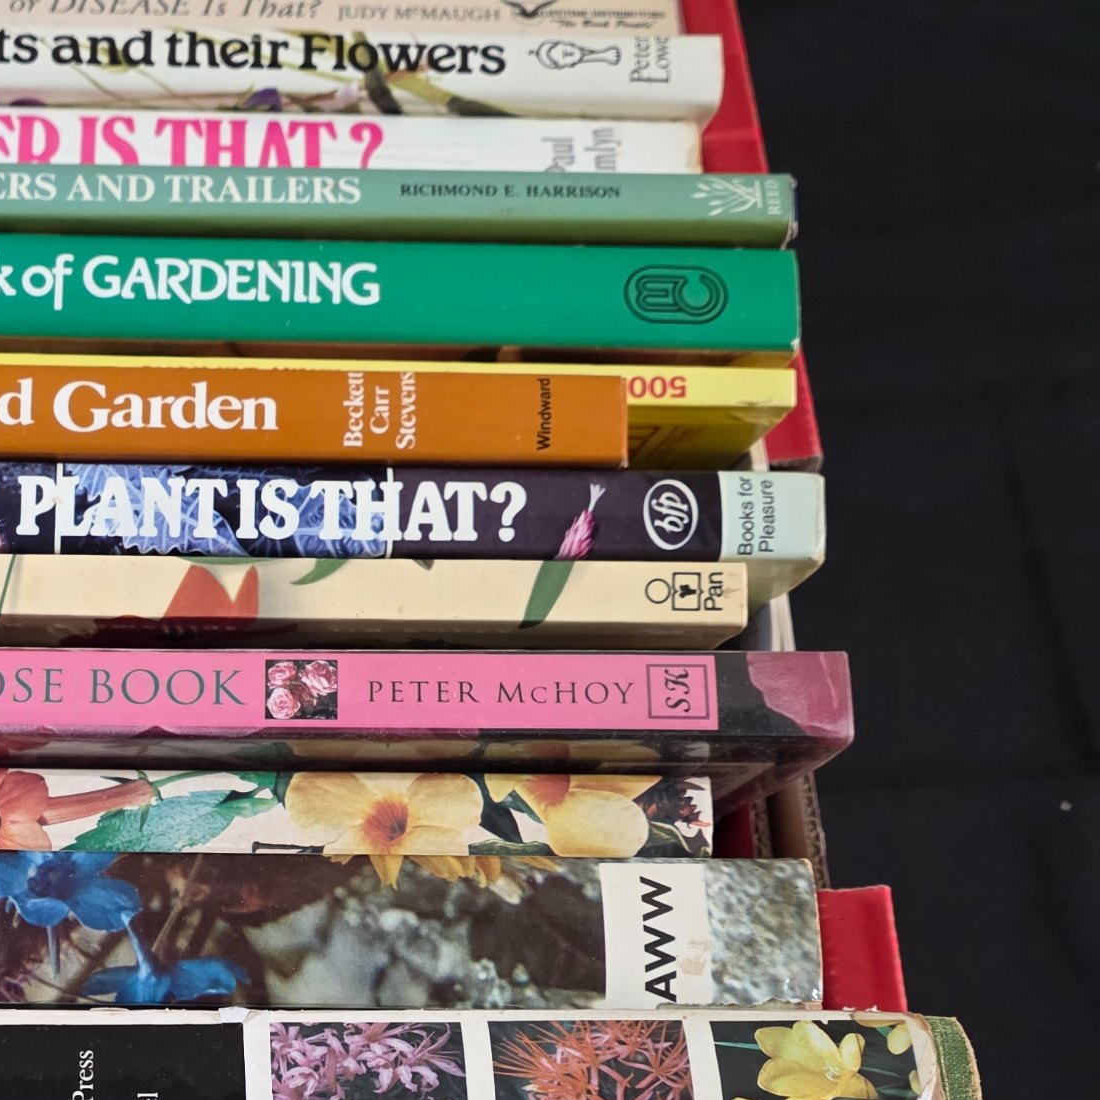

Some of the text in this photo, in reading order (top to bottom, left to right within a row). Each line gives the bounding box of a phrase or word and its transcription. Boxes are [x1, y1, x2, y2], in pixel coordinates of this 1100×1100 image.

[336, 5, 389, 22] JUDY
[51, 31, 152, 66] and
[166, 33, 290, 69] their
[299, 34, 506, 74] Flowers
[67, 173, 154, 202] AND
[164, 174, 362, 205] TRAILERS
[400, 183, 621, 198] RICHMOND E. HARRISON
[19, 252, 71, 310] of
[82, 256, 381, 305] GARDENING
[53, 380, 279, 434] Garden
[369, 385, 390, 434] Carr
[395, 371, 416, 449] Stevens
[628, 376, 687, 399] 500
[536, 377, 552, 451] Windward
[16, 475, 227, 539] PLANT
[237, 478, 307, 540] IS
[310, 479, 527, 543] THAT?
[738, 476, 753, 555] Books for
[758, 479, 776, 552] Pleasure
[704, 571, 724, 611] Pan
[89, 667, 246, 706] BOOK
[367, 678, 480, 705] PETER
[642, 875, 675, 1001] AWW
